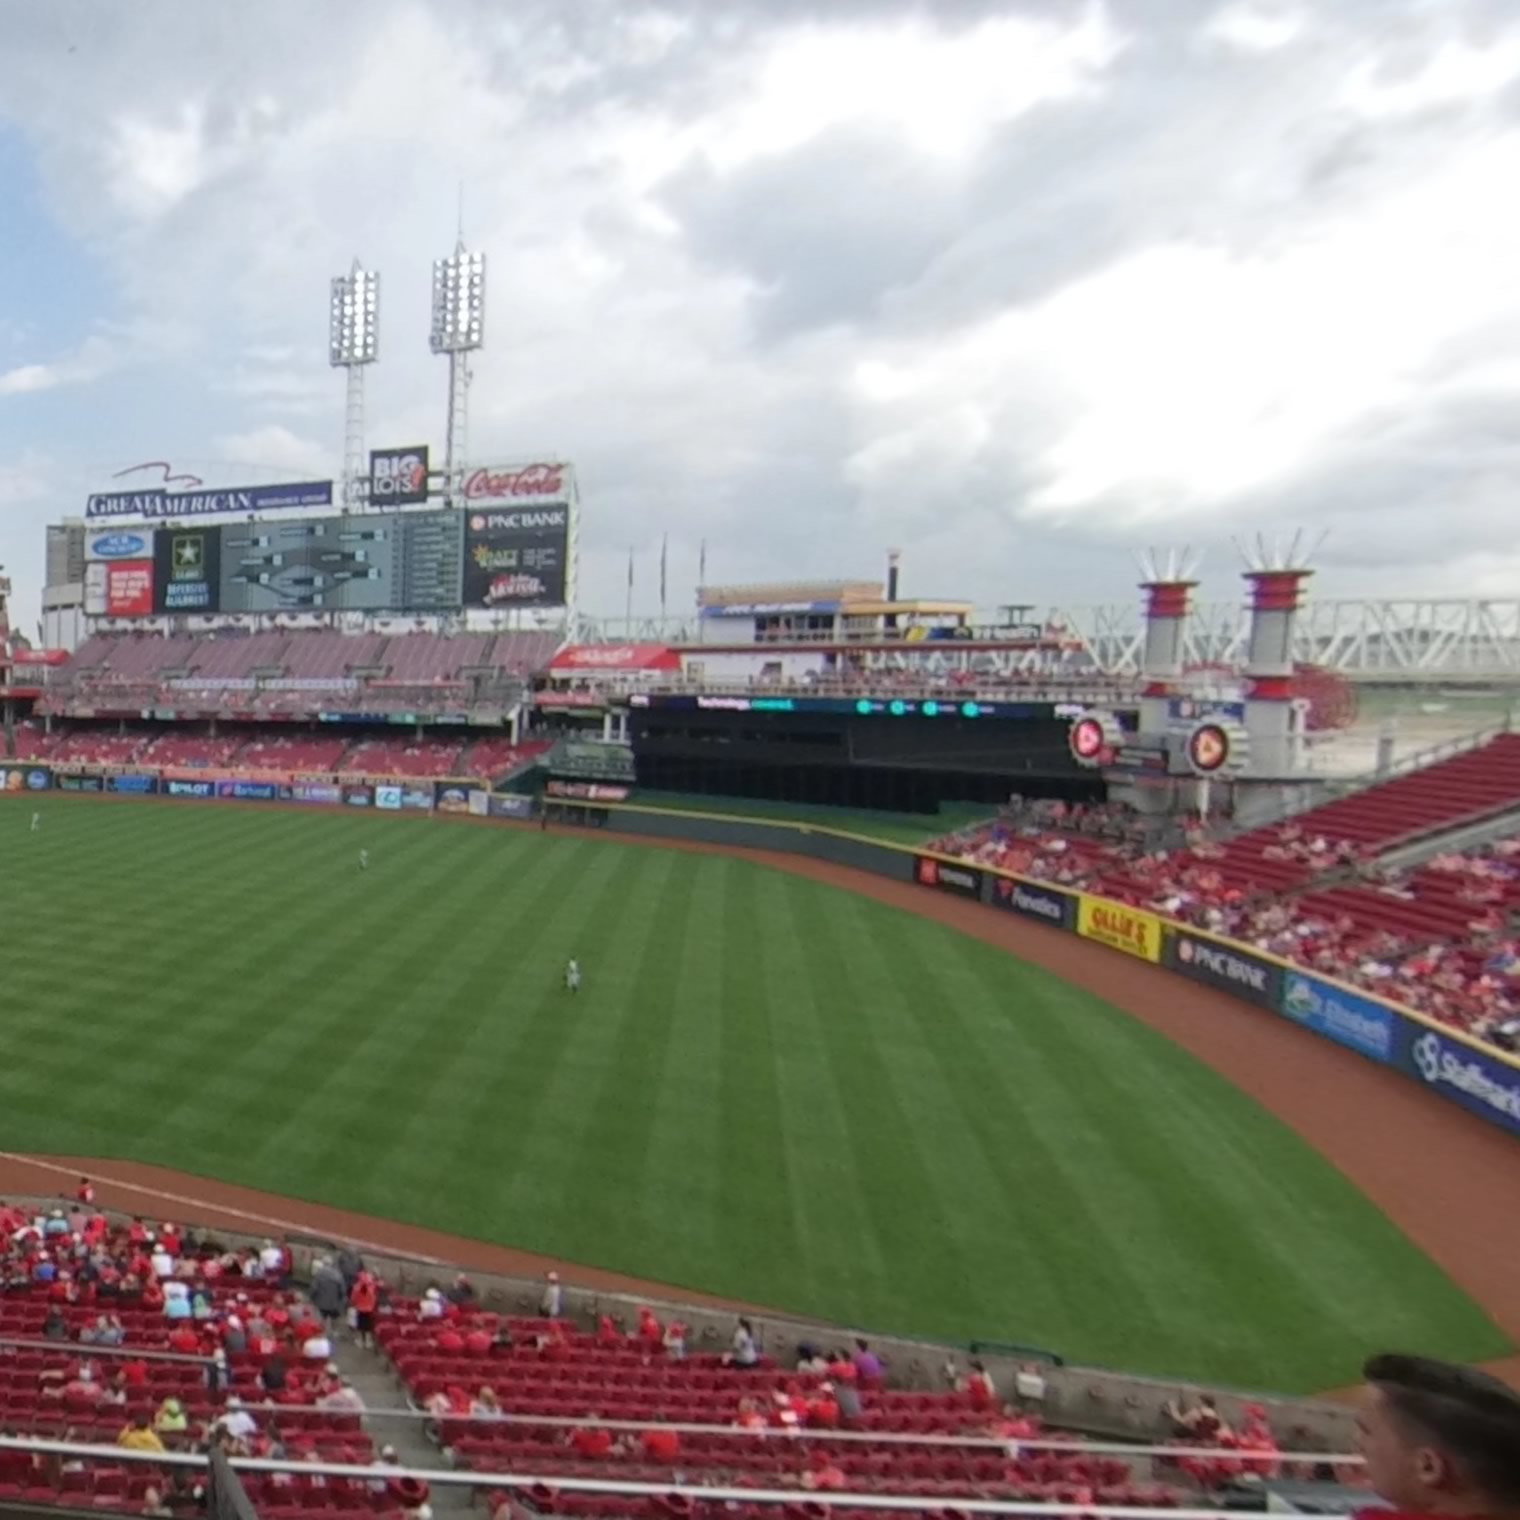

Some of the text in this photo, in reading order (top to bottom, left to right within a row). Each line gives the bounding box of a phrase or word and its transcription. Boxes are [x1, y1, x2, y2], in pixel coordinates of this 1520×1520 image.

[373, 455, 420, 478] BIG
[465, 463, 564, 499] Coca-Cola
[147, 493, 252, 515] AMERICAN
[487, 511, 564, 529] PNC BANK
[1194, 944, 1268, 991] PNC BANK
